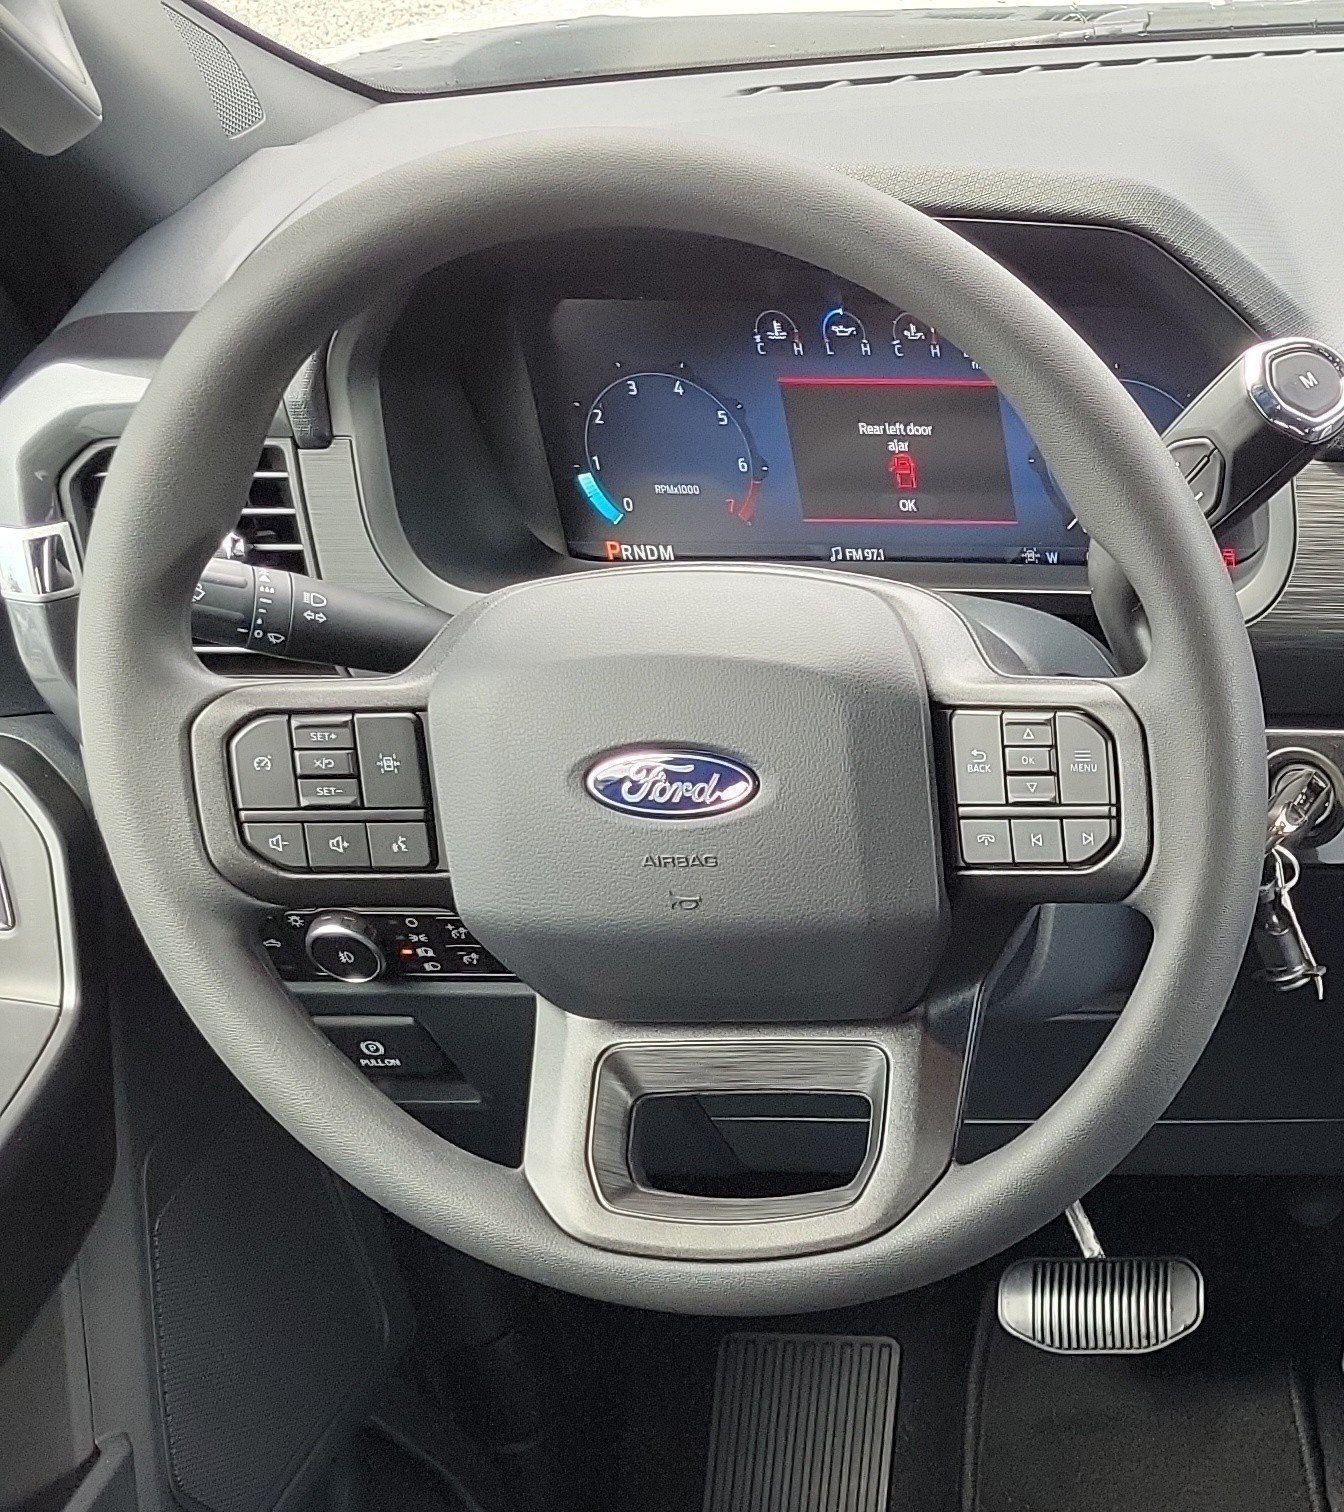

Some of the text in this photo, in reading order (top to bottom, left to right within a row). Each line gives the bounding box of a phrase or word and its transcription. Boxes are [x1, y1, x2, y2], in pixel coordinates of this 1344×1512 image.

[757, 343, 766, 355] C
[793, 343, 803, 355] H
[826, 343, 834, 355] L
[861, 343, 871, 355] H
[895, 345, 903, 356] C
[930, 345, 941, 358] H
[1299, 372, 1318, 389] M
[626, 380, 638, 395] 3
[674, 380, 684, 395] 4
[593, 410, 604, 424] 2
[717, 410, 728, 425] 5
[858, 422, 932, 435] Rear left door
[888, 439, 908, 453] ajar
[593, 456, 600, 470] 1
[738, 458, 748, 472] 6
[654, 485, 700, 495] RPMx1000
[623, 498, 633, 511] 0
[899, 499, 917, 511] OK
[845, 549, 884, 560] FM 97.1
[1045, 552, 1057, 563] W
[1022, 756, 1035, 765] OK
[967, 764, 991, 773] BACK
[1070, 764, 1097, 772] MENU
[621, 762, 719, 804] Ford
[642, 854, 718, 868] AIRBAG
[360, 1058, 400, 1067] PULL ON
